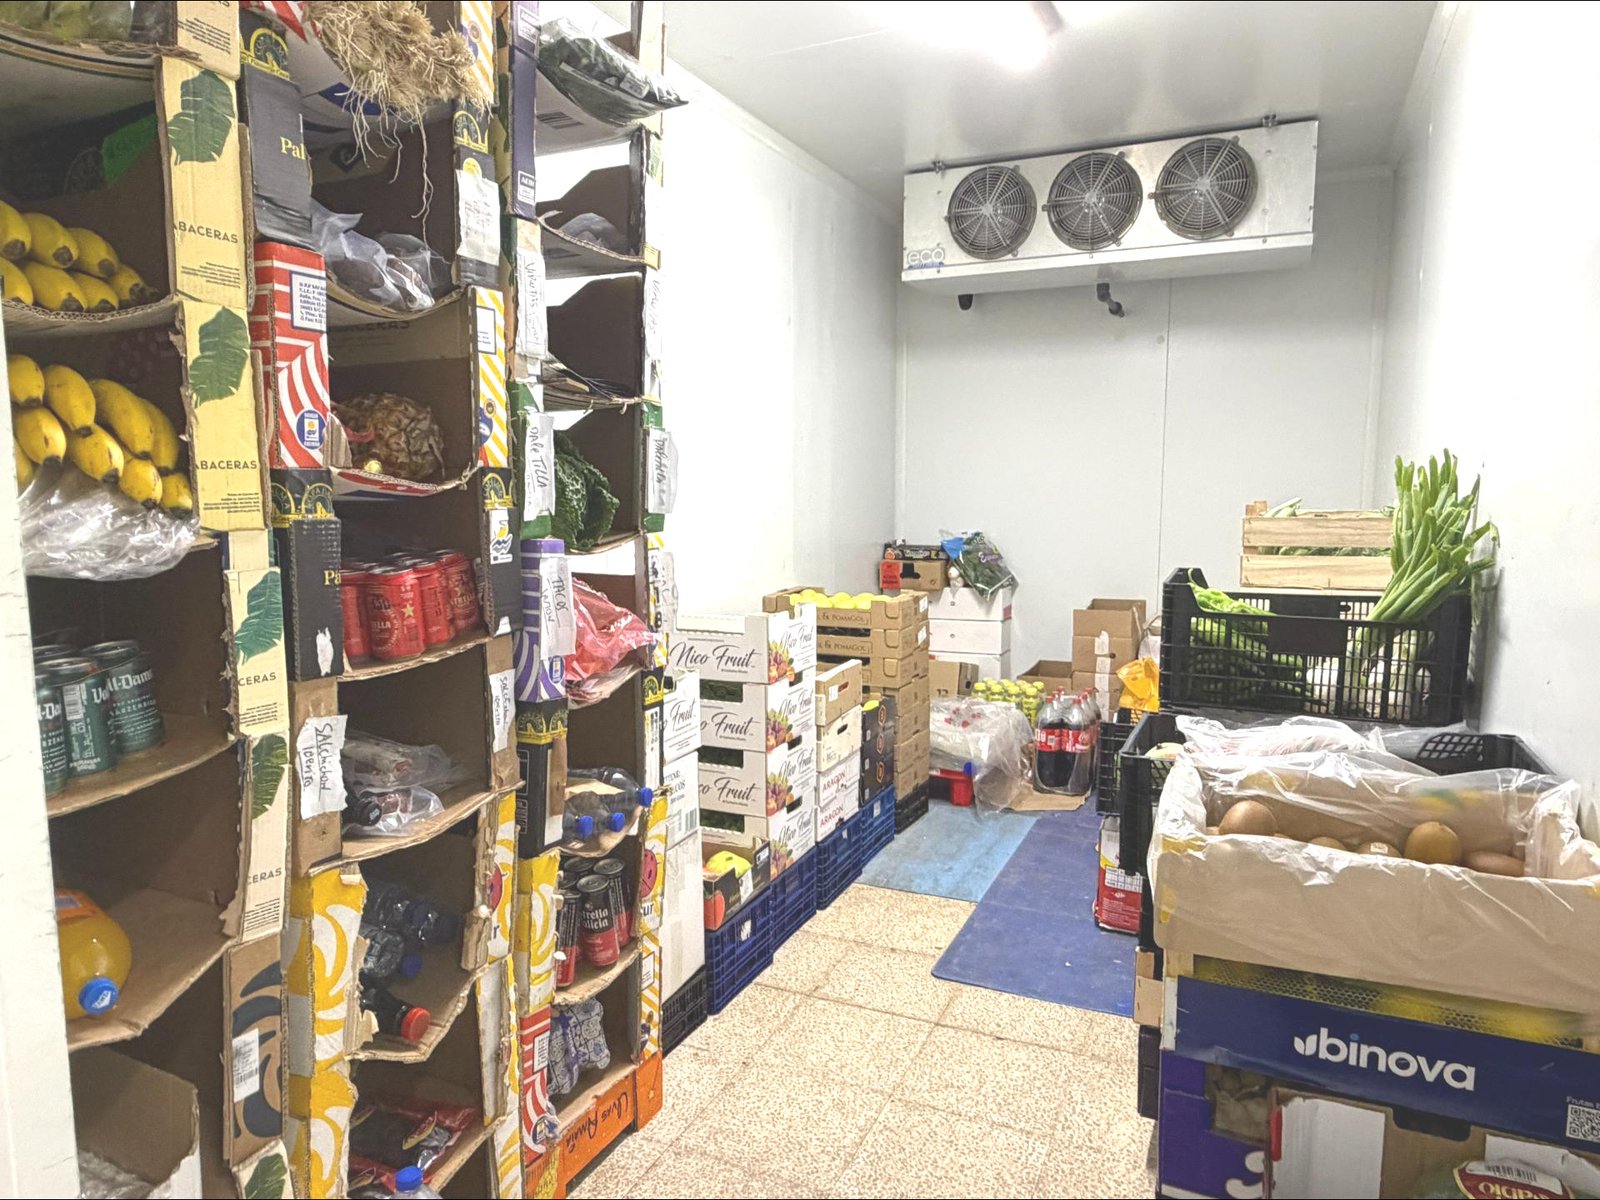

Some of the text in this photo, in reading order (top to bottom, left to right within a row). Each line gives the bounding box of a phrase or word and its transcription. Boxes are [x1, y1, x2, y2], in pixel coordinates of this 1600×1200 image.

[907, 247, 945, 266] eco
[669, 641, 762, 671] Nico Fruit
[669, 698, 697, 732] Fruit
[711, 711, 760, 738] Fruit
[714, 776, 761, 802] Fruit
[1318, 1026, 1476, 1092] binova
